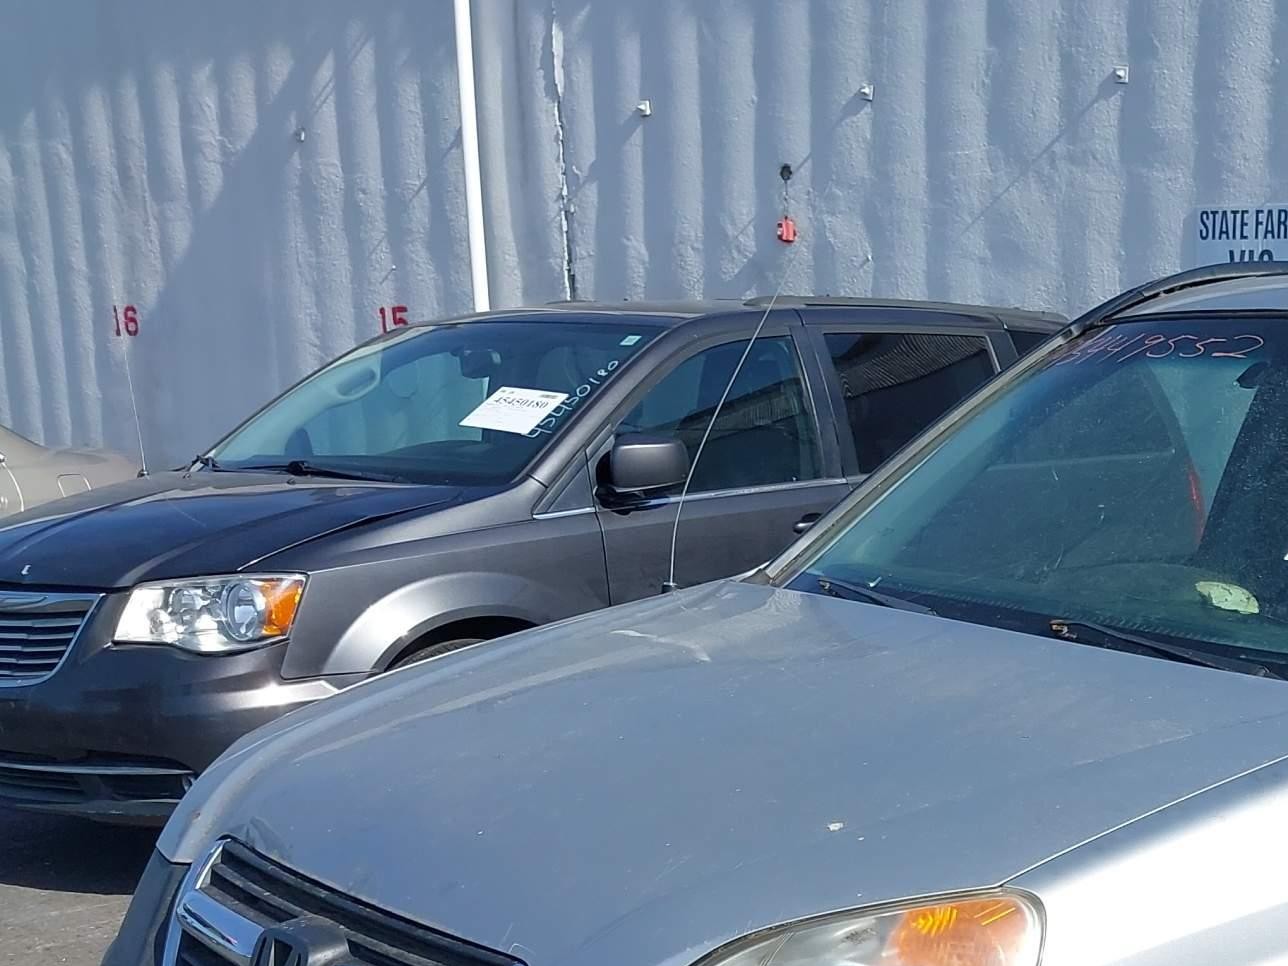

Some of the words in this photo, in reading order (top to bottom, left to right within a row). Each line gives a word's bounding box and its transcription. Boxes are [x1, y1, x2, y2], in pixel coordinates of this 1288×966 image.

[1199, 210, 1249, 240] STATE
[113, 305, 139, 336] 16
[379, 306, 408, 334] 15
